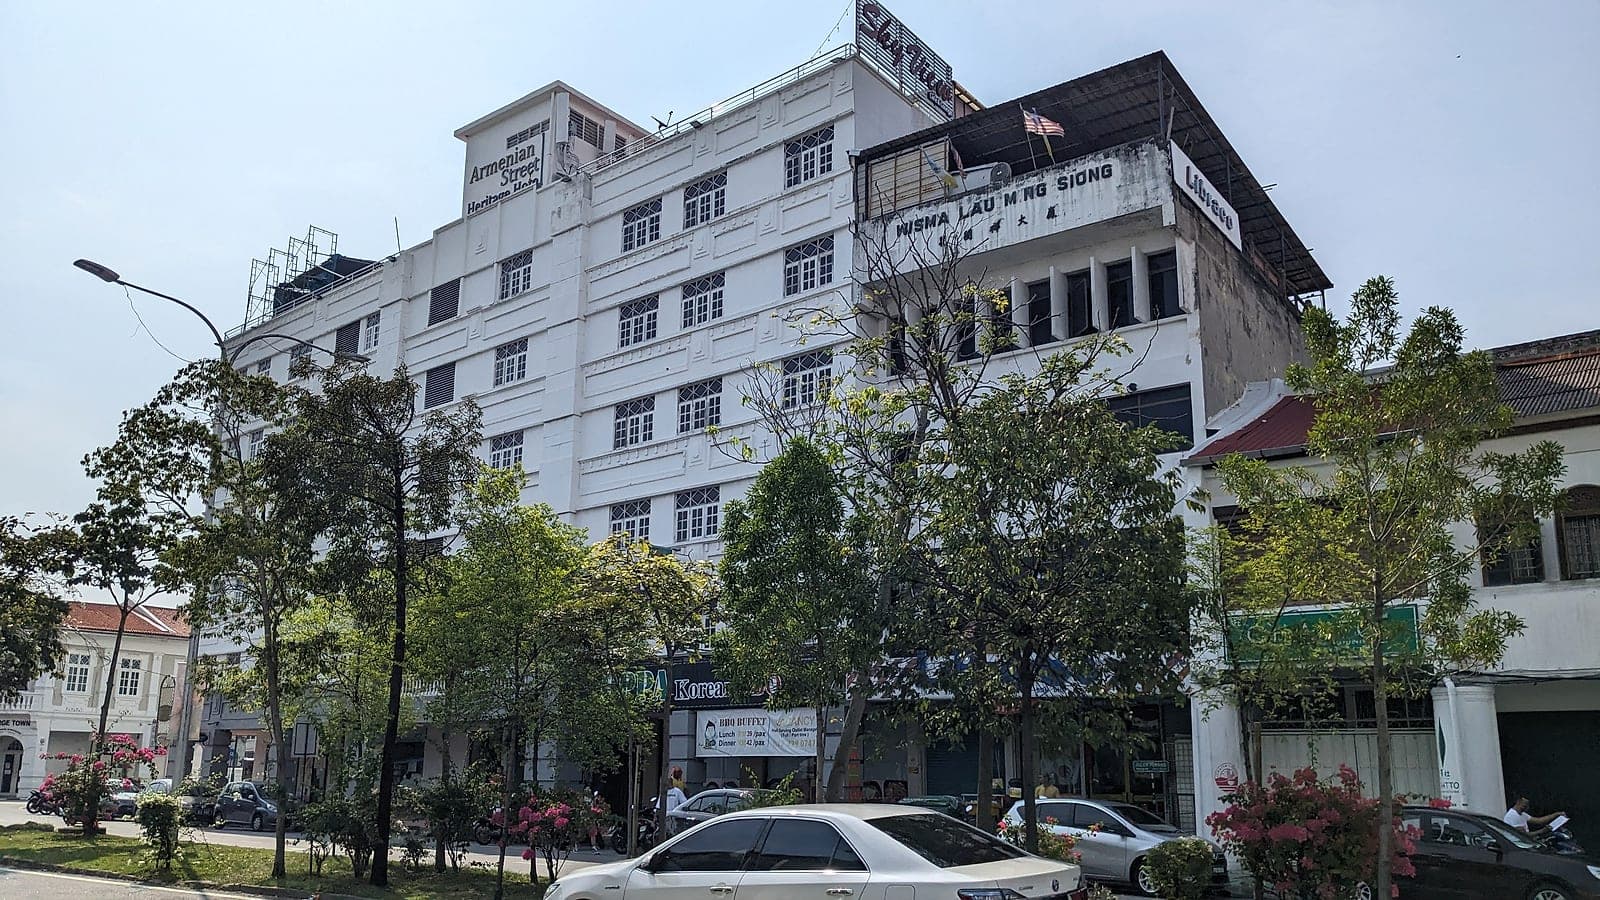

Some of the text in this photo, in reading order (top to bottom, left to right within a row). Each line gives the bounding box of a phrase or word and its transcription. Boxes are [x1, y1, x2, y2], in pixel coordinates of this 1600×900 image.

[859, 4, 904, 66] Sky
[470, 144, 535, 184] Armenian
[500, 157, 540, 186] Street
[897, 164, 1112, 236] WISMA LAU MNG SIONG
[12, 719, 31, 727] TOWN
[737, 717, 767, 726] BUFFET
[718, 739, 736, 747] Dinner
